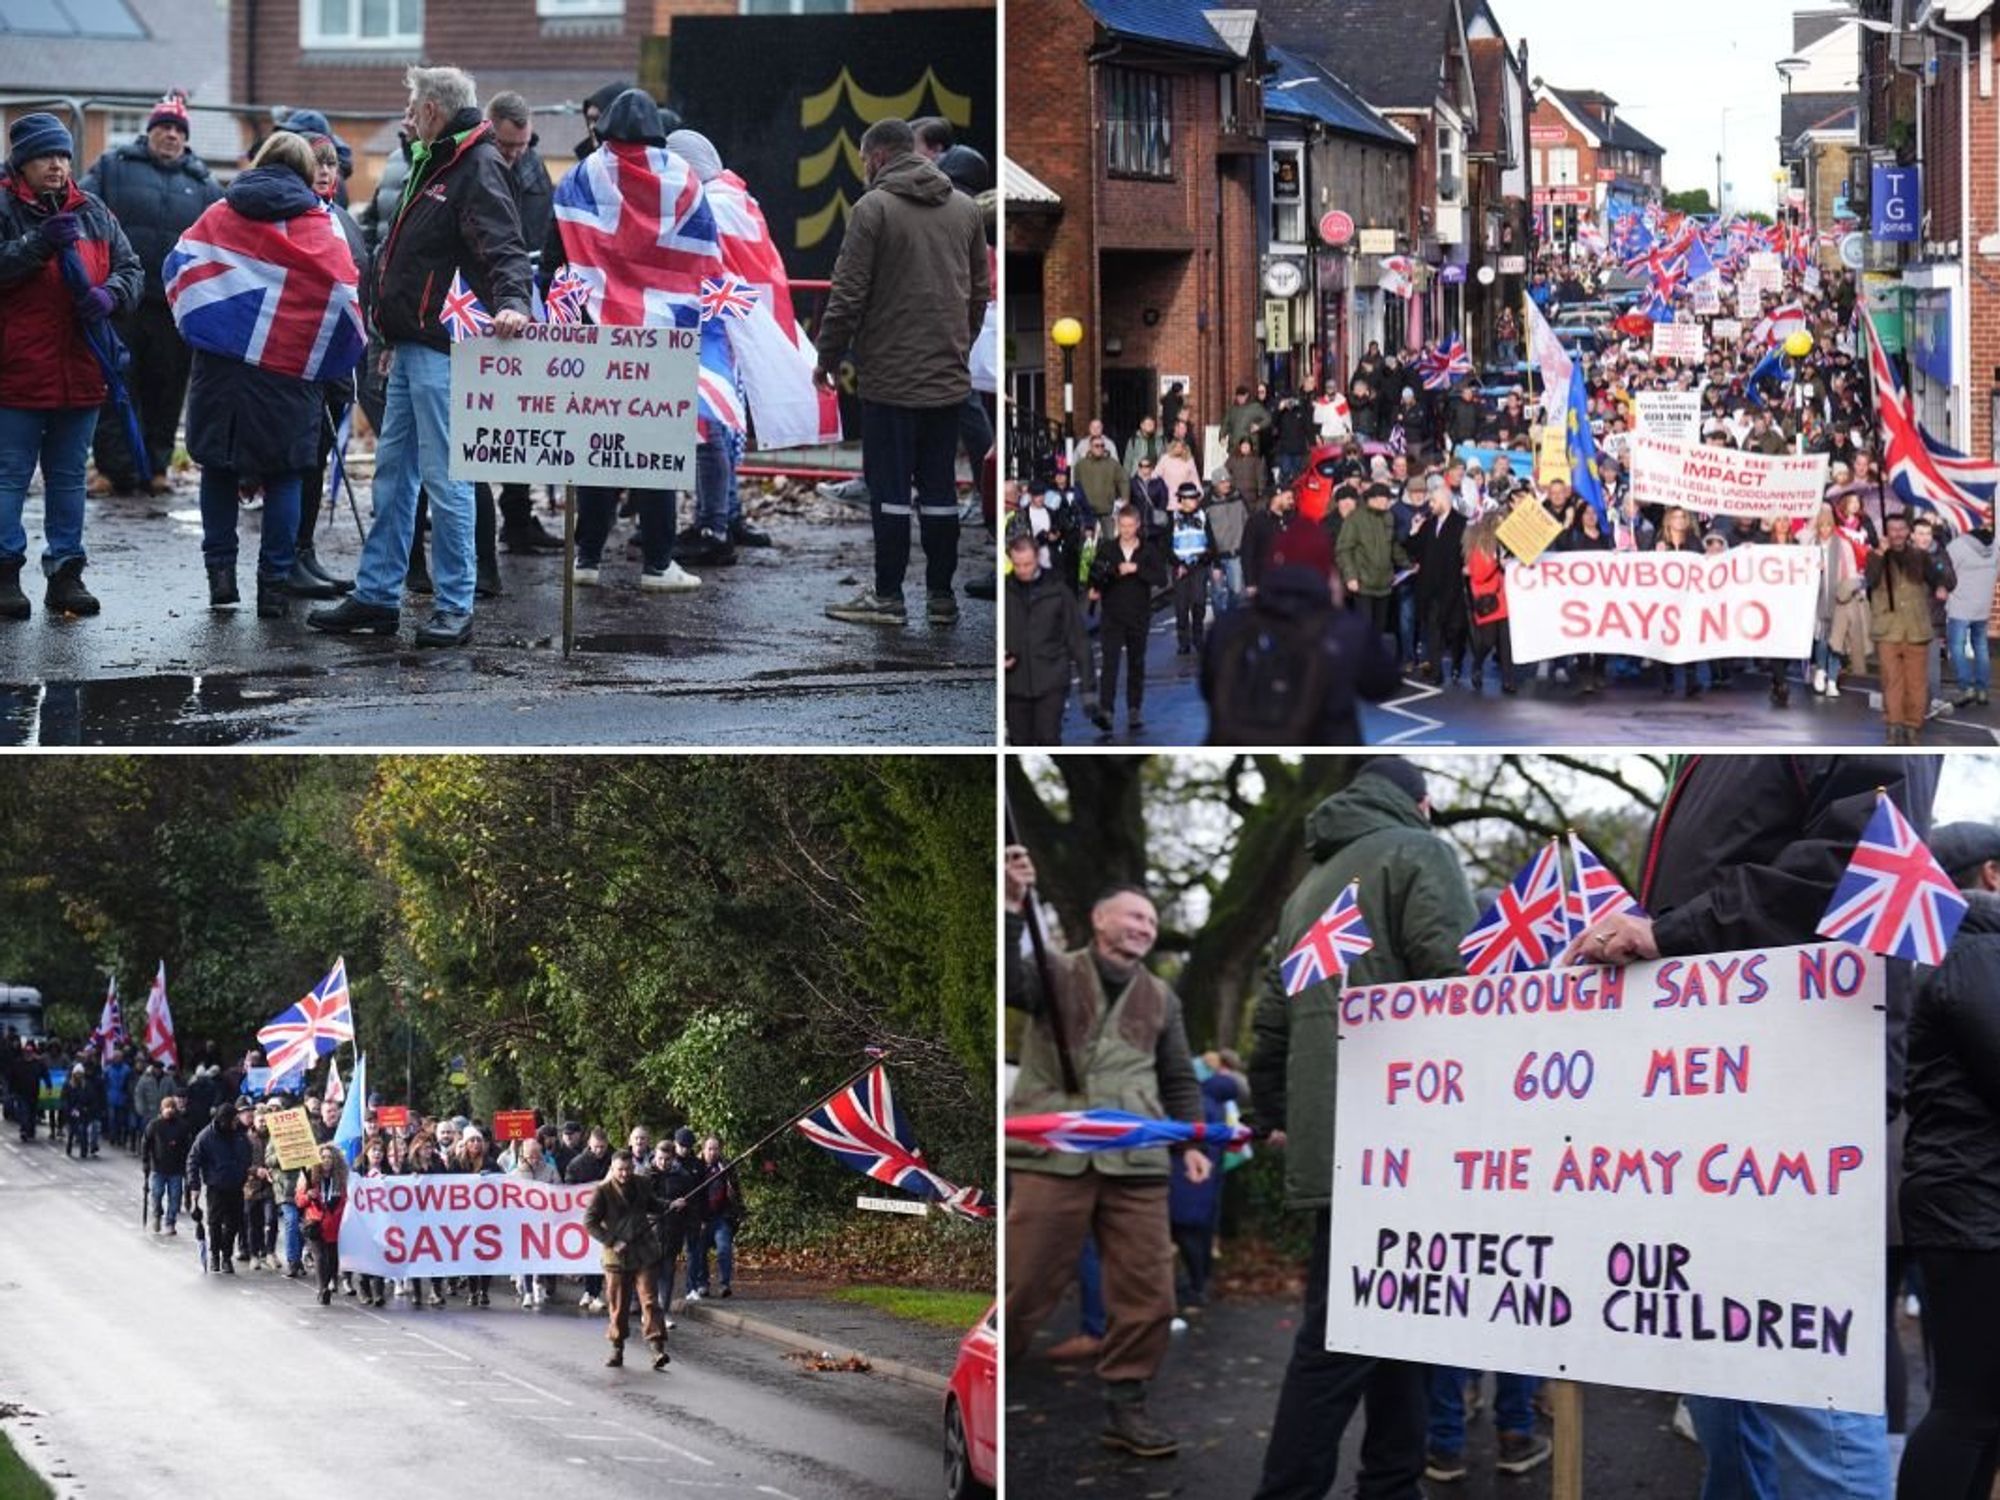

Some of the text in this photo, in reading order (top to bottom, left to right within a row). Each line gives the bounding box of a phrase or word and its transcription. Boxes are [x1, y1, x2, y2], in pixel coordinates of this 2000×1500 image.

[1886, 174, 1904, 196] T
[1886, 198, 1905, 220] G
[473, 322, 694, 349] OBOROUGH SAYS NO
[479, 356, 650, 380] FOR 600 MEN
[466, 392, 691, 418] IN THE ARMY CAMP
[476, 427, 626, 452] PROTECT OUR
[1637, 437, 1681, 456] THIS
[1690, 451, 1736, 467] WILL
[1745, 459, 1772, 470] BE
[1782, 460, 1818, 470] THE
[462, 443, 686, 472] WOMEN AND CHILDREN
[1673, 475, 1717, 494] ILLEGAL
[1722, 488, 1817, 500] UNDOCUMENTED
[1682, 461, 1767, 487] IMPACT
[1687, 493, 1718, 508] OUR
[1513, 556, 1812, 593] CROWBOROUGH
[1559, 600, 1772, 646] SAYS NO
[1341, 948, 1866, 1026] CROWBOROUGH SAYS NO
[1386, 1045, 1749, 1105] FOR 600 MEN
[1361, 1143, 1863, 1196] IN THE ARMY CAMP
[353, 1182, 593, 1214] CROWBOROUG
[384, 1221, 590, 1264] SAYS NO
[1376, 1228, 1691, 1291] PROTECT OUR
[1351, 1265, 1853, 1357] WOMEN AND CHILDREN
